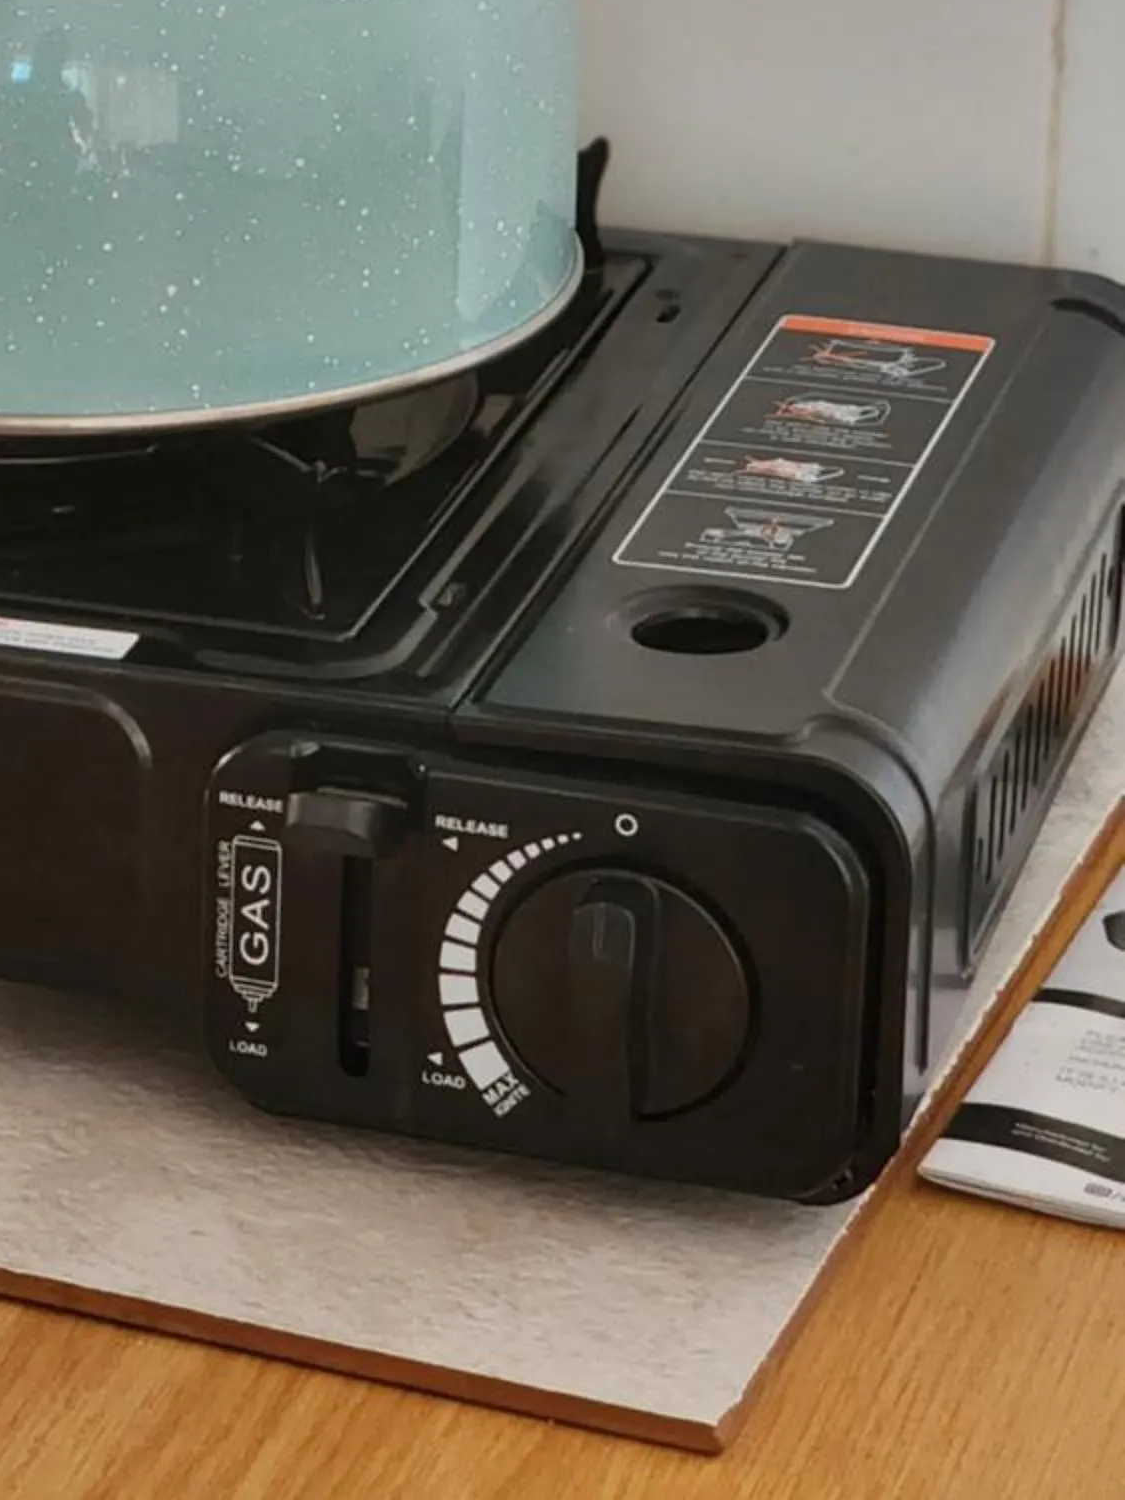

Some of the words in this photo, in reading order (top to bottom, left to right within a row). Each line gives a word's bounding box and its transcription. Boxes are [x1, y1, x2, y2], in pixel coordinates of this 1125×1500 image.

[219, 790, 283, 813] RELEASE
[435, 815, 508, 838] RELEASE
[218, 839, 231, 887] LEVER
[239, 865, 272, 966] GAS
[215, 897, 229, 978] CARTRIDGE
[229, 1040, 268, 1057] LOAD
[421, 1070, 466, 1090] LOAD
[481, 1071, 519, 1107] MAX
